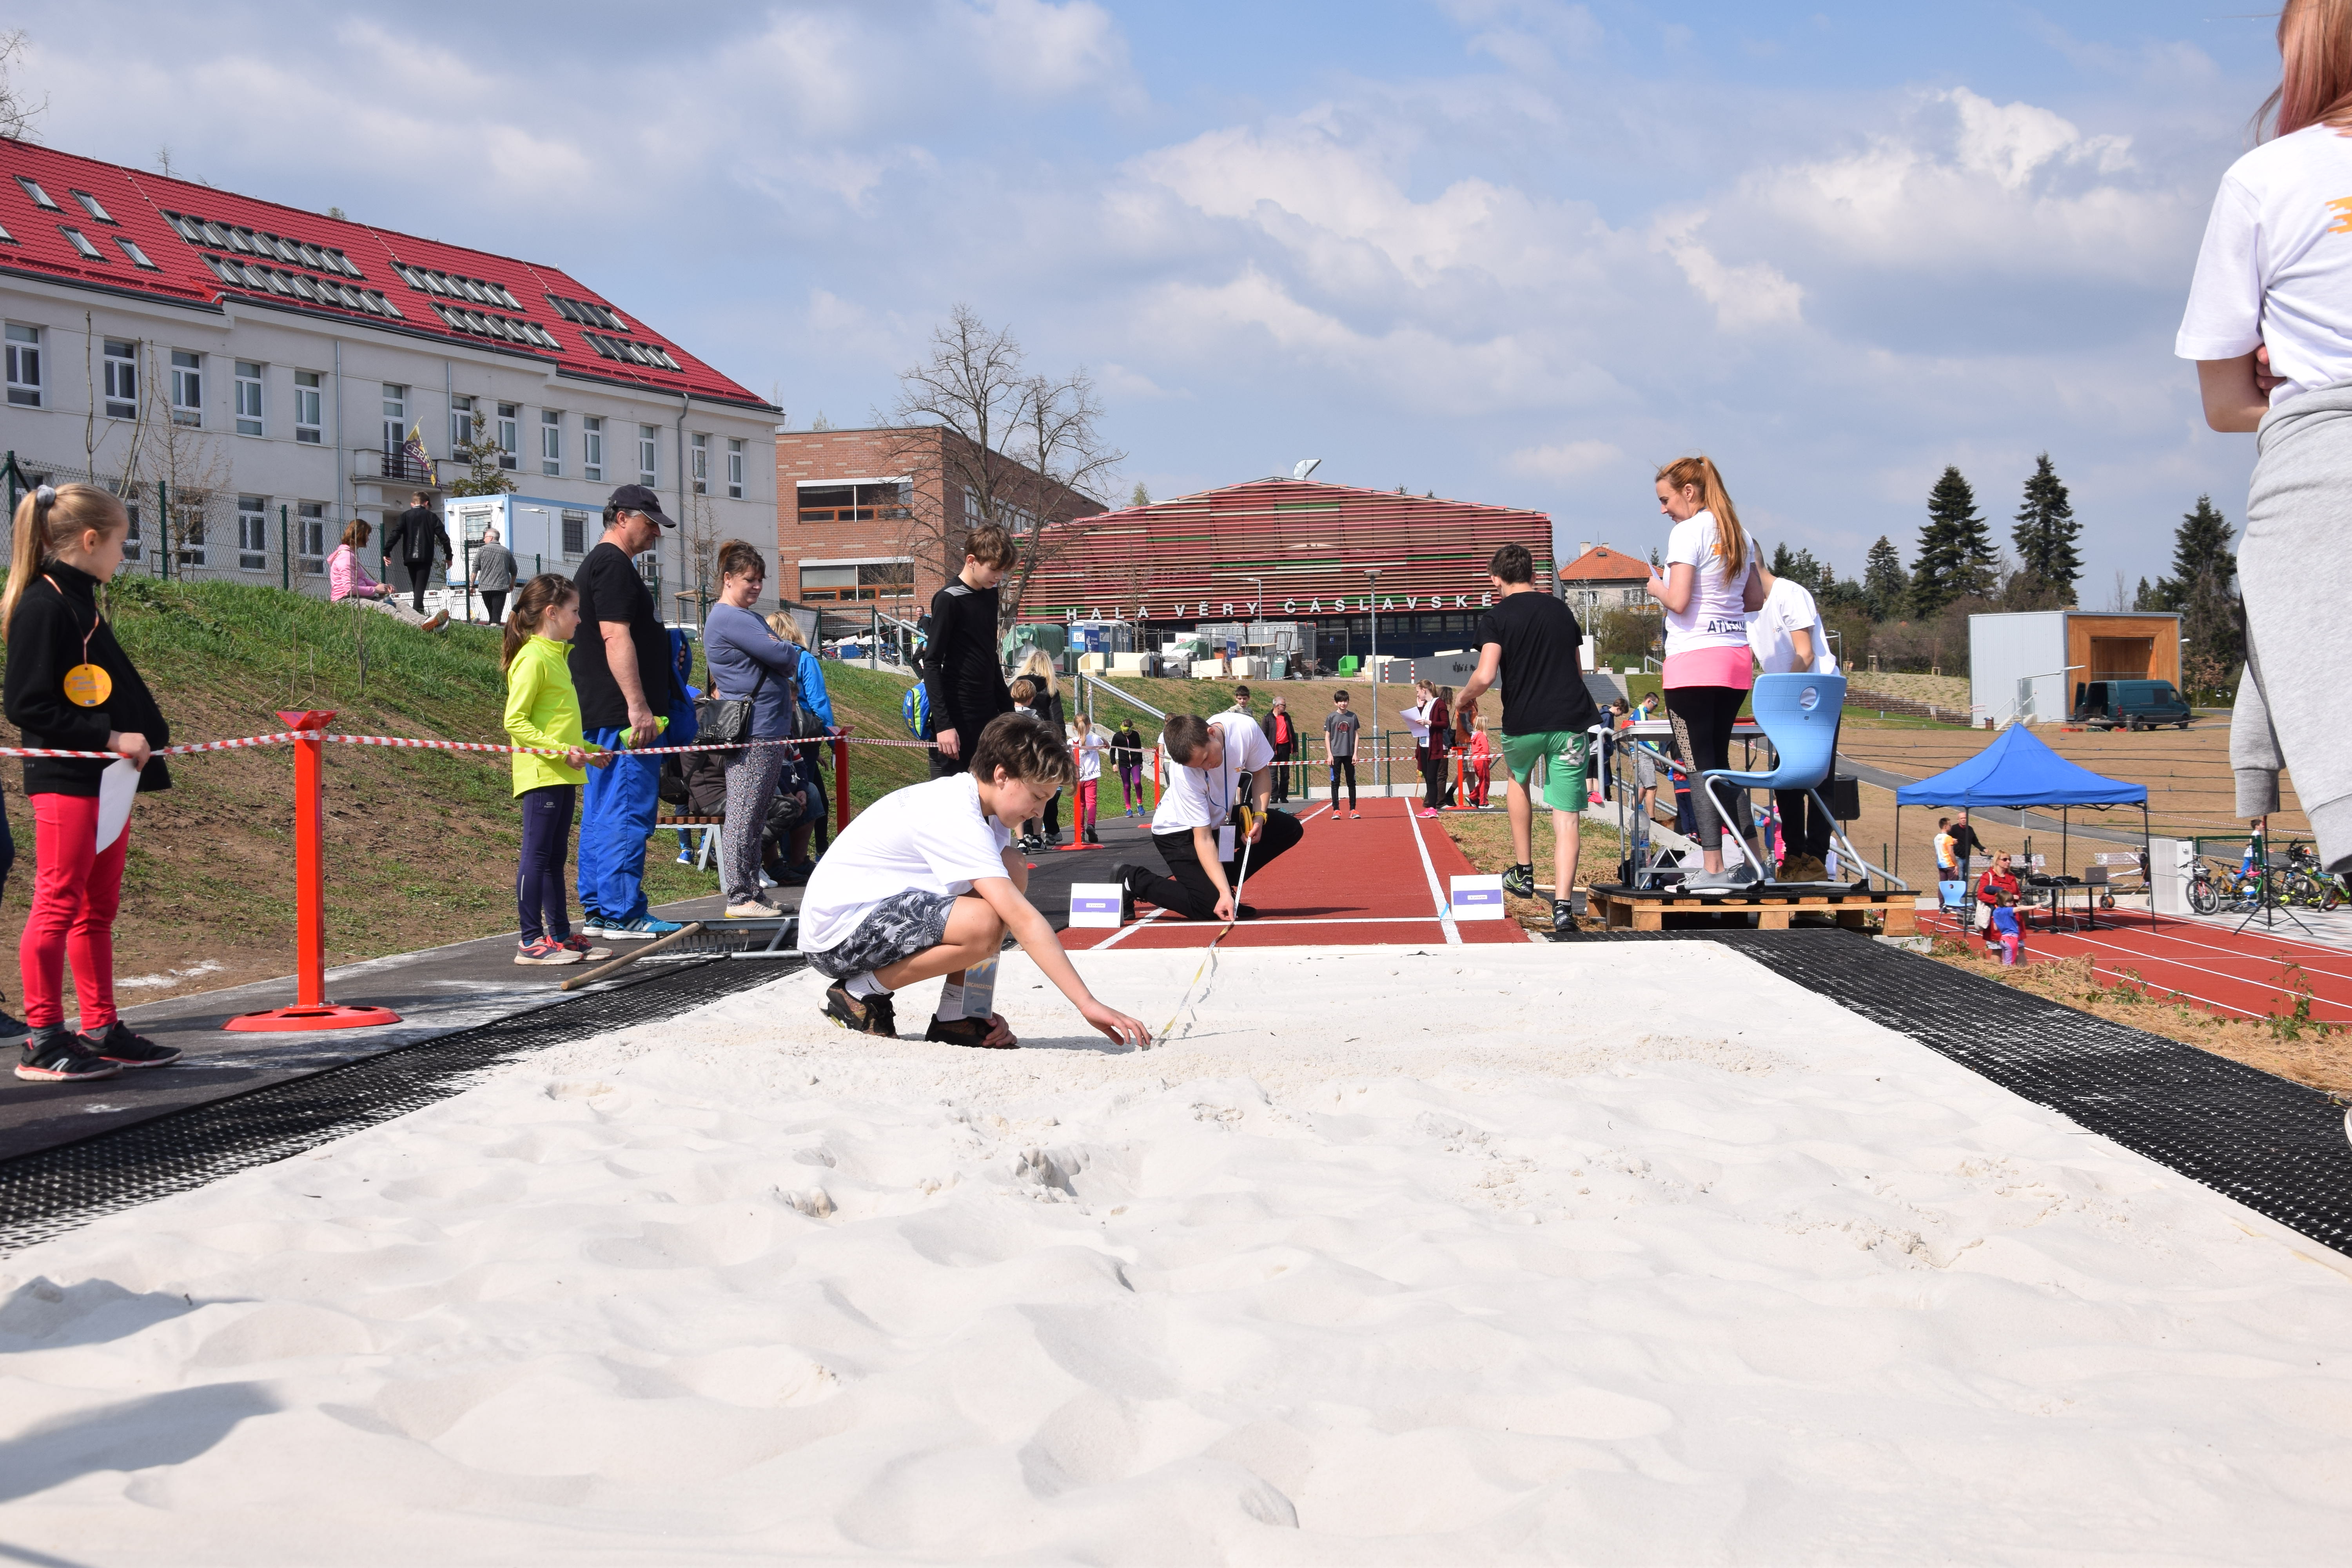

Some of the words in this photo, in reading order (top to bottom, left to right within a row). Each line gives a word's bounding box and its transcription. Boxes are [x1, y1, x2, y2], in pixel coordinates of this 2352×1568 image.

[1066, 606, 1149, 620] HALA
[1174, 601, 1258, 617] VĚRY
[1284, 592, 1492, 613] ČÁSLAVSKÉ
